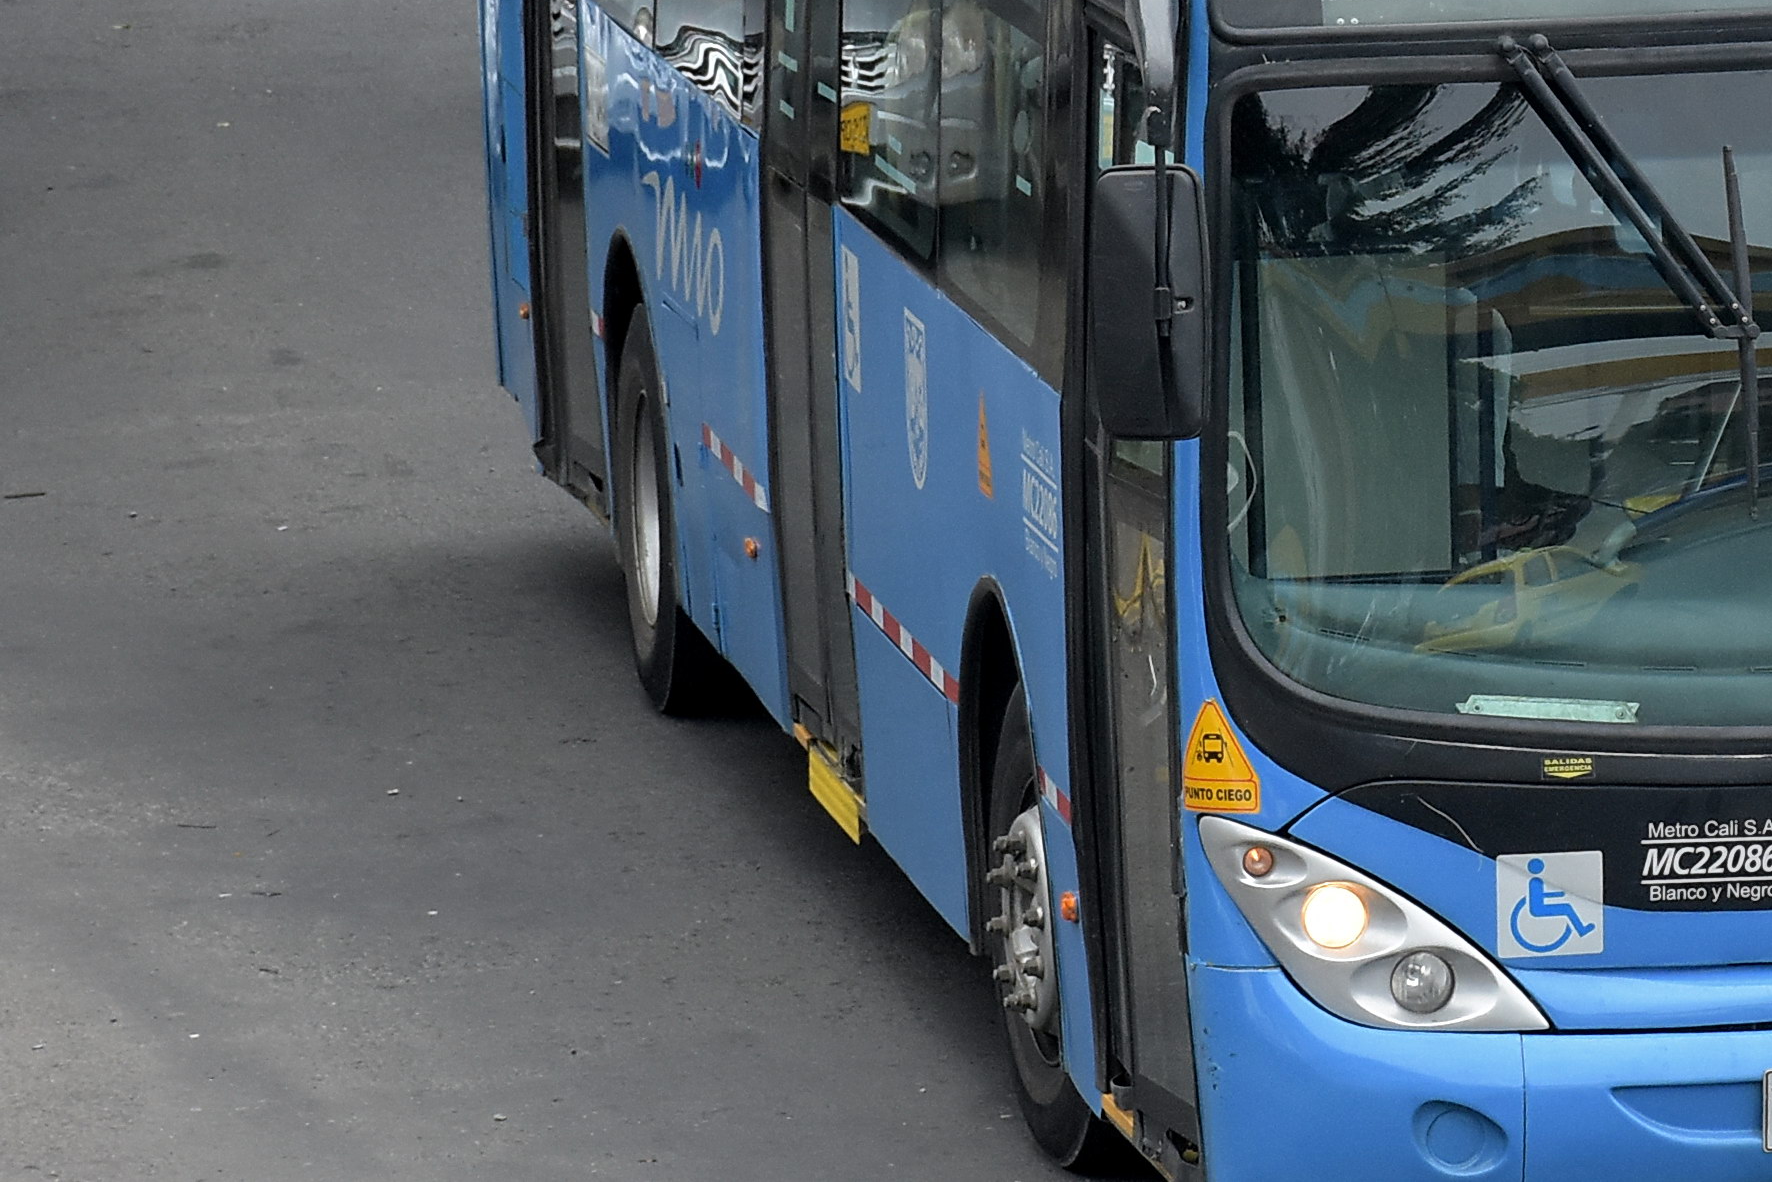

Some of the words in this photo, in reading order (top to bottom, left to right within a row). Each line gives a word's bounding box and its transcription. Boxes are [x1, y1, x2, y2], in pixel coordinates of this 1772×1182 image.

[1544, 757, 1592, 765] SALIDAS
[1544, 764, 1592, 772] EMERGENCIA
[1184, 786, 1213, 800] PUNTO
[1216, 788, 1252, 802] CIEGO
[1648, 821, 1699, 838] Metro
[1704, 819, 1739, 837] Cali
[1649, 885, 1707, 902] Blanco
[1711, 885, 1723, 903] y
